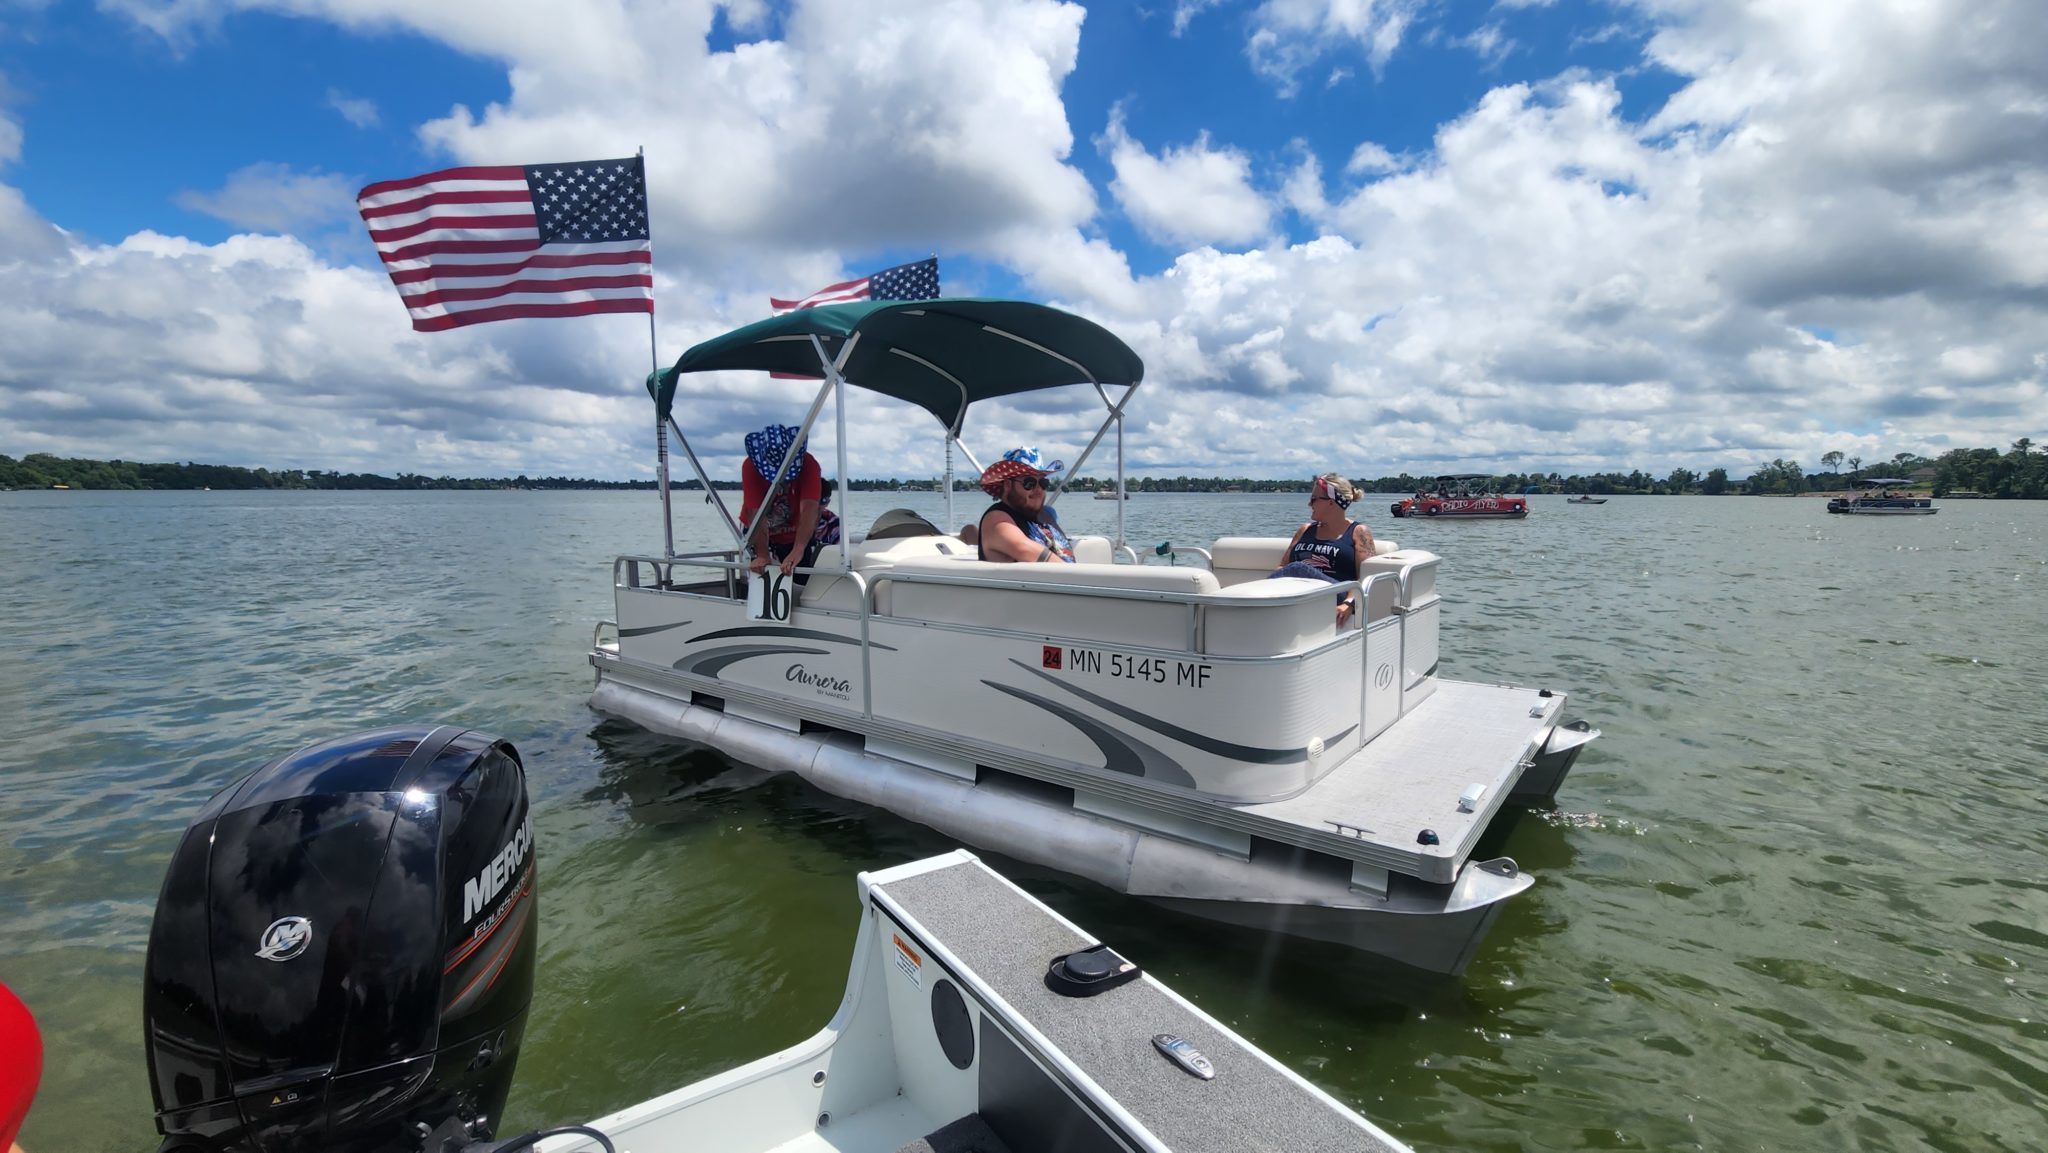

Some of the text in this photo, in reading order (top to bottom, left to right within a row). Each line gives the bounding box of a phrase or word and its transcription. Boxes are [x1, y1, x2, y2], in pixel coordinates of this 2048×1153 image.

[1441, 500, 1468, 512] RADIO
[1294, 543, 1340, 557] OLD NAVY
[755, 570, 790, 621] 16
[1043, 654, 1061, 666] 24
[1070, 649, 1212, 688] MN 5145 MF
[464, 810, 532, 924] MERCU
